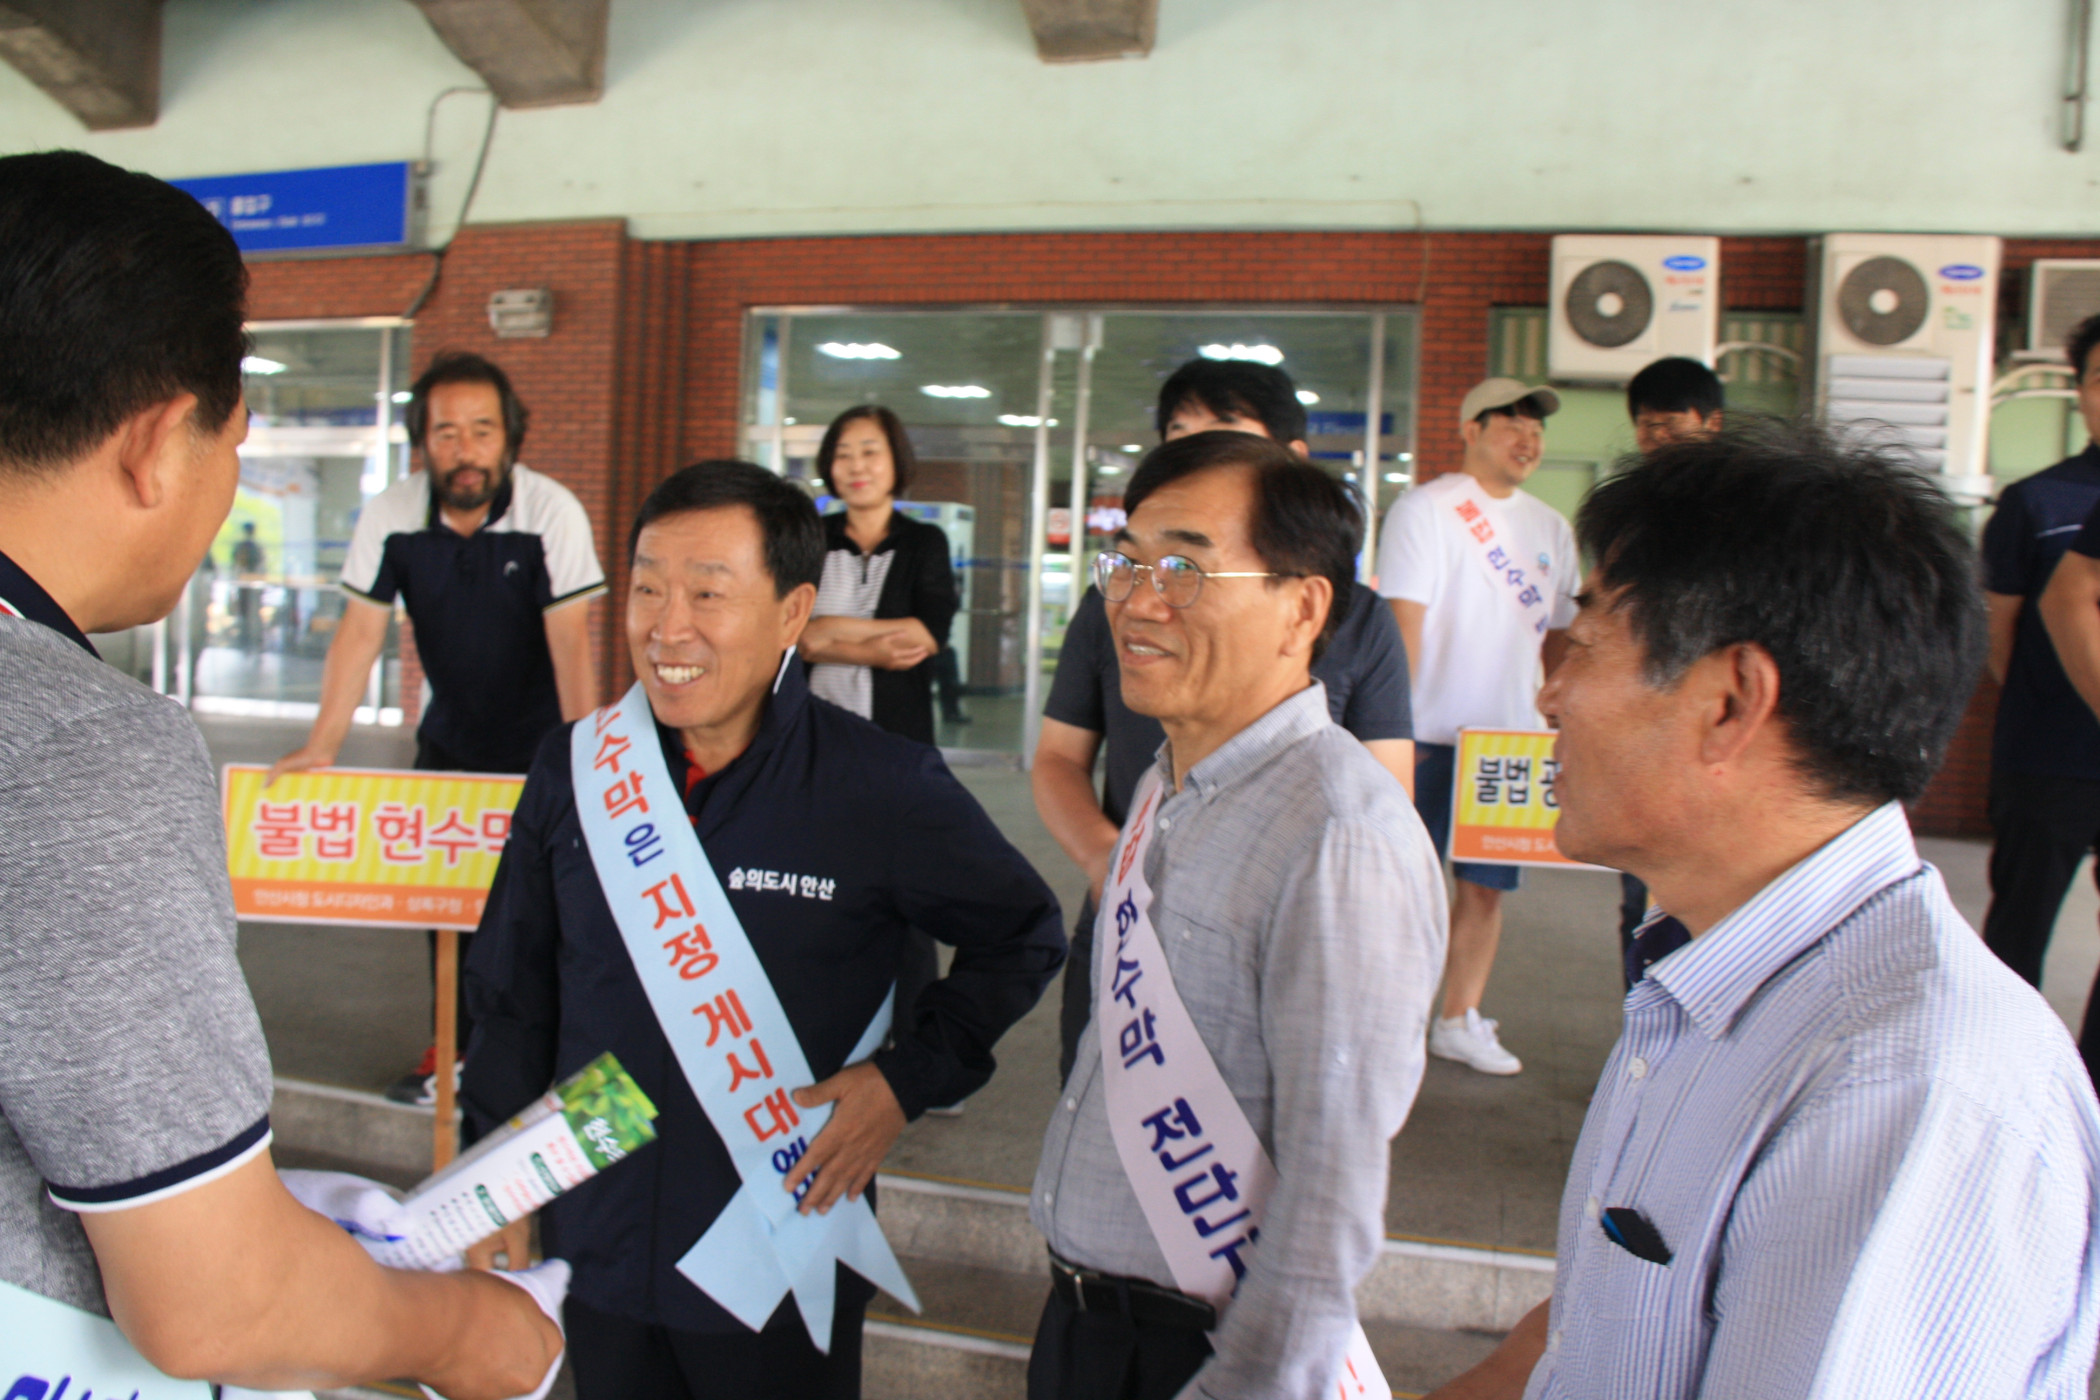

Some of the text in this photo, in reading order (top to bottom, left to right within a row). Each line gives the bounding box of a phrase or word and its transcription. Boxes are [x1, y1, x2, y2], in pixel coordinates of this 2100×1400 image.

[1475, 757, 1530, 804] 불법
[254, 803, 356, 860] 불법
[728, 867, 836, 900] 숲의도시 안산
[641, 872, 719, 980] 지정
[1111, 887, 1165, 1069] 현수막
